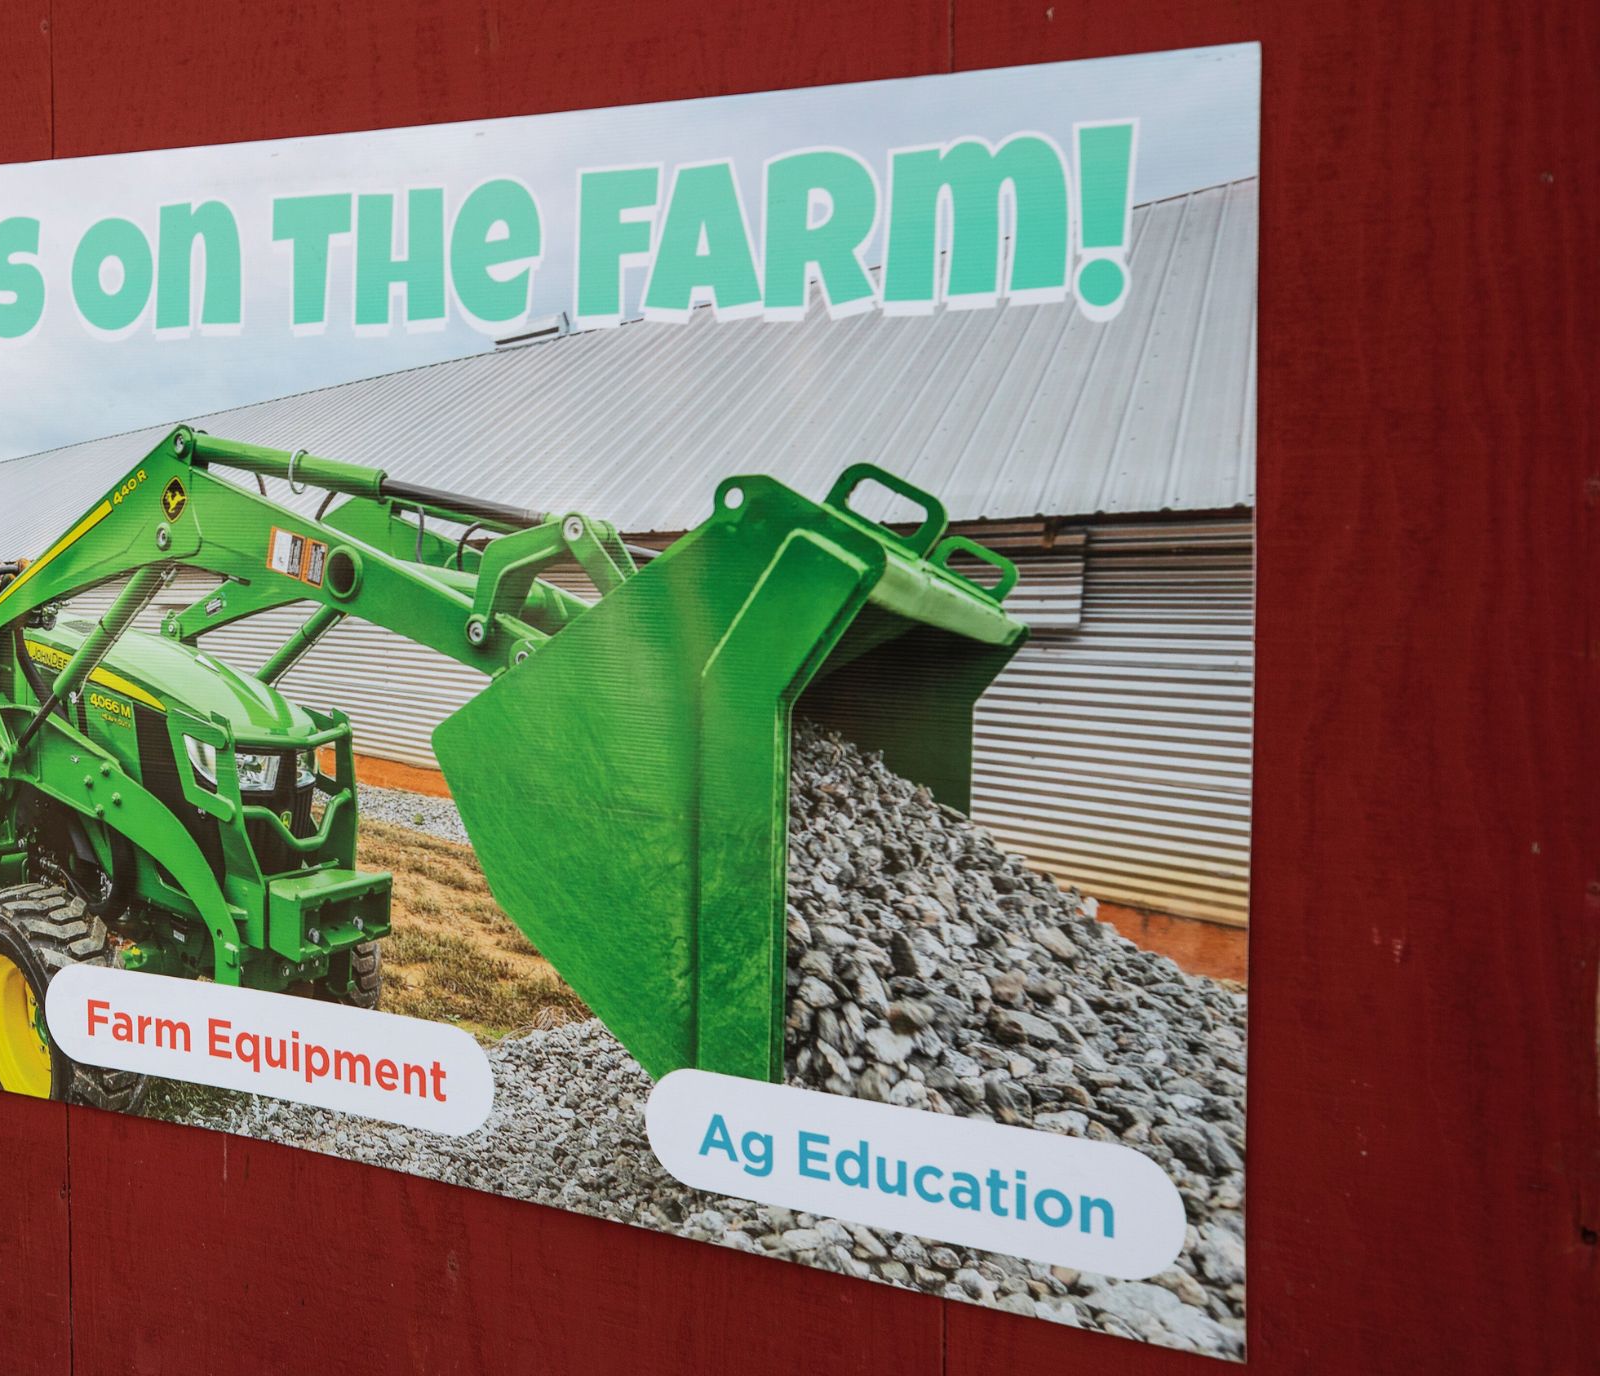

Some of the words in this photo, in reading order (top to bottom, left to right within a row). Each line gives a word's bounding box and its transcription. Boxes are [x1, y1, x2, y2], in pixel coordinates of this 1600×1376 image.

[113, 478, 137, 505] 440
[136, 469, 148, 483] R
[90, 692, 120, 714] 4066
[120, 703, 131, 719] M
[87, 999, 191, 1053] Farm
[207, 1018, 447, 1103] Equipment
[698, 1113, 774, 1178] Ag
[797, 1130, 1115, 1239] Education
